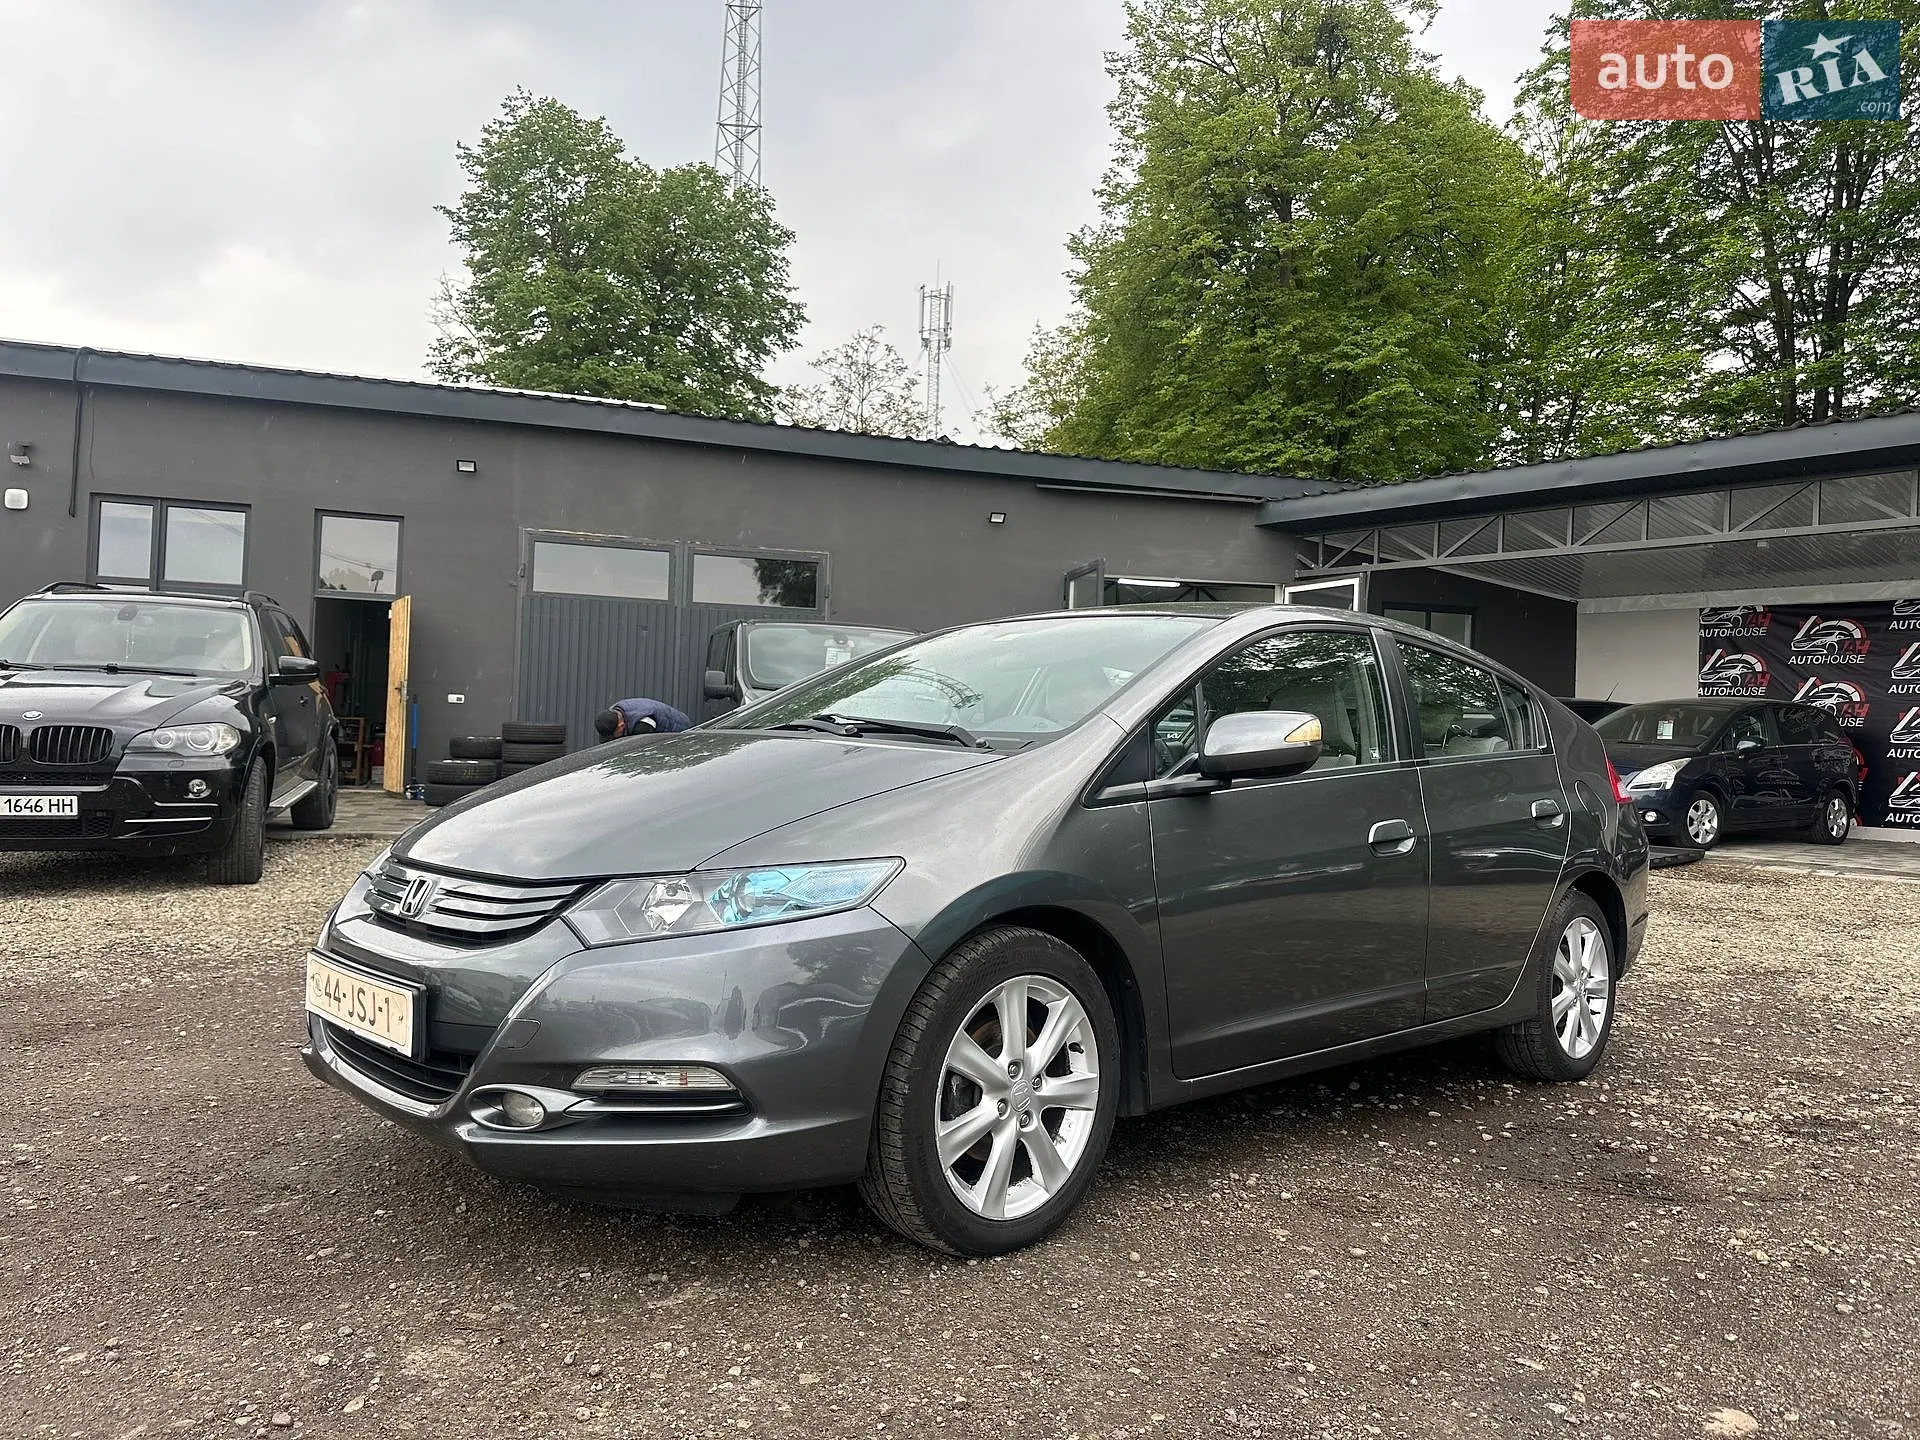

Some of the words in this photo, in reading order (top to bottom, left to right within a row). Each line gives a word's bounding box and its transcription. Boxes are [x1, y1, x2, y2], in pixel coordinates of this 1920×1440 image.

[1699, 627, 1767, 638] AUTOHOUSE
[1788, 654, 1866, 665] AUTOHOUSE
[1698, 686, 1766, 696] AUTOHOUSE
[4, 798, 44, 813] 1646
[48, 798, 74, 813] HH
[324, 974, 391, 1033] 44-JSJ-1
